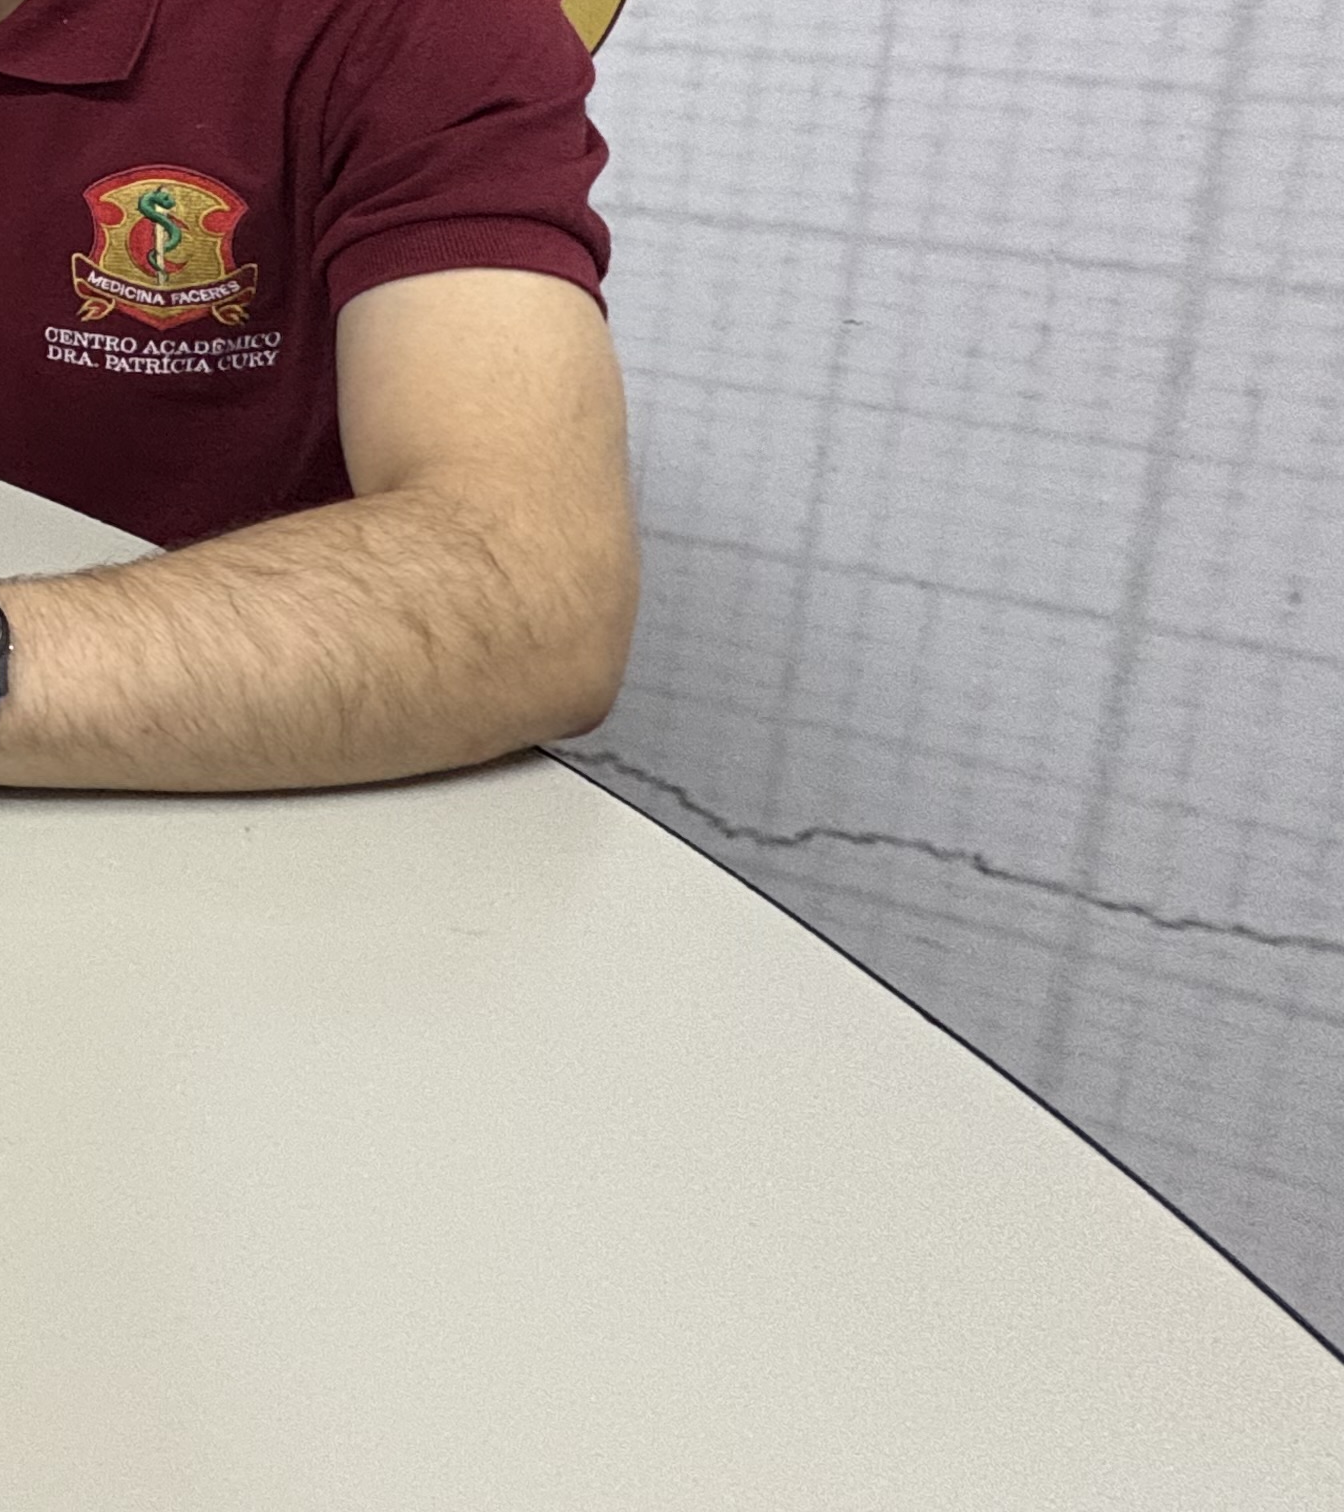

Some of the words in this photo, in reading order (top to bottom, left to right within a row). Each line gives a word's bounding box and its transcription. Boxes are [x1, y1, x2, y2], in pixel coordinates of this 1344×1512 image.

[87, 270, 165, 306] MEDICINA
[170, 280, 242, 306] FACERES
[44, 326, 138, 354] CENTRO
[141, 331, 282, 356] ACADÊMICO
[47, 344, 100, 368] DRA.
[104, 354, 213, 375] PATRÍCIA
[217, 349, 280, 372] CURY
